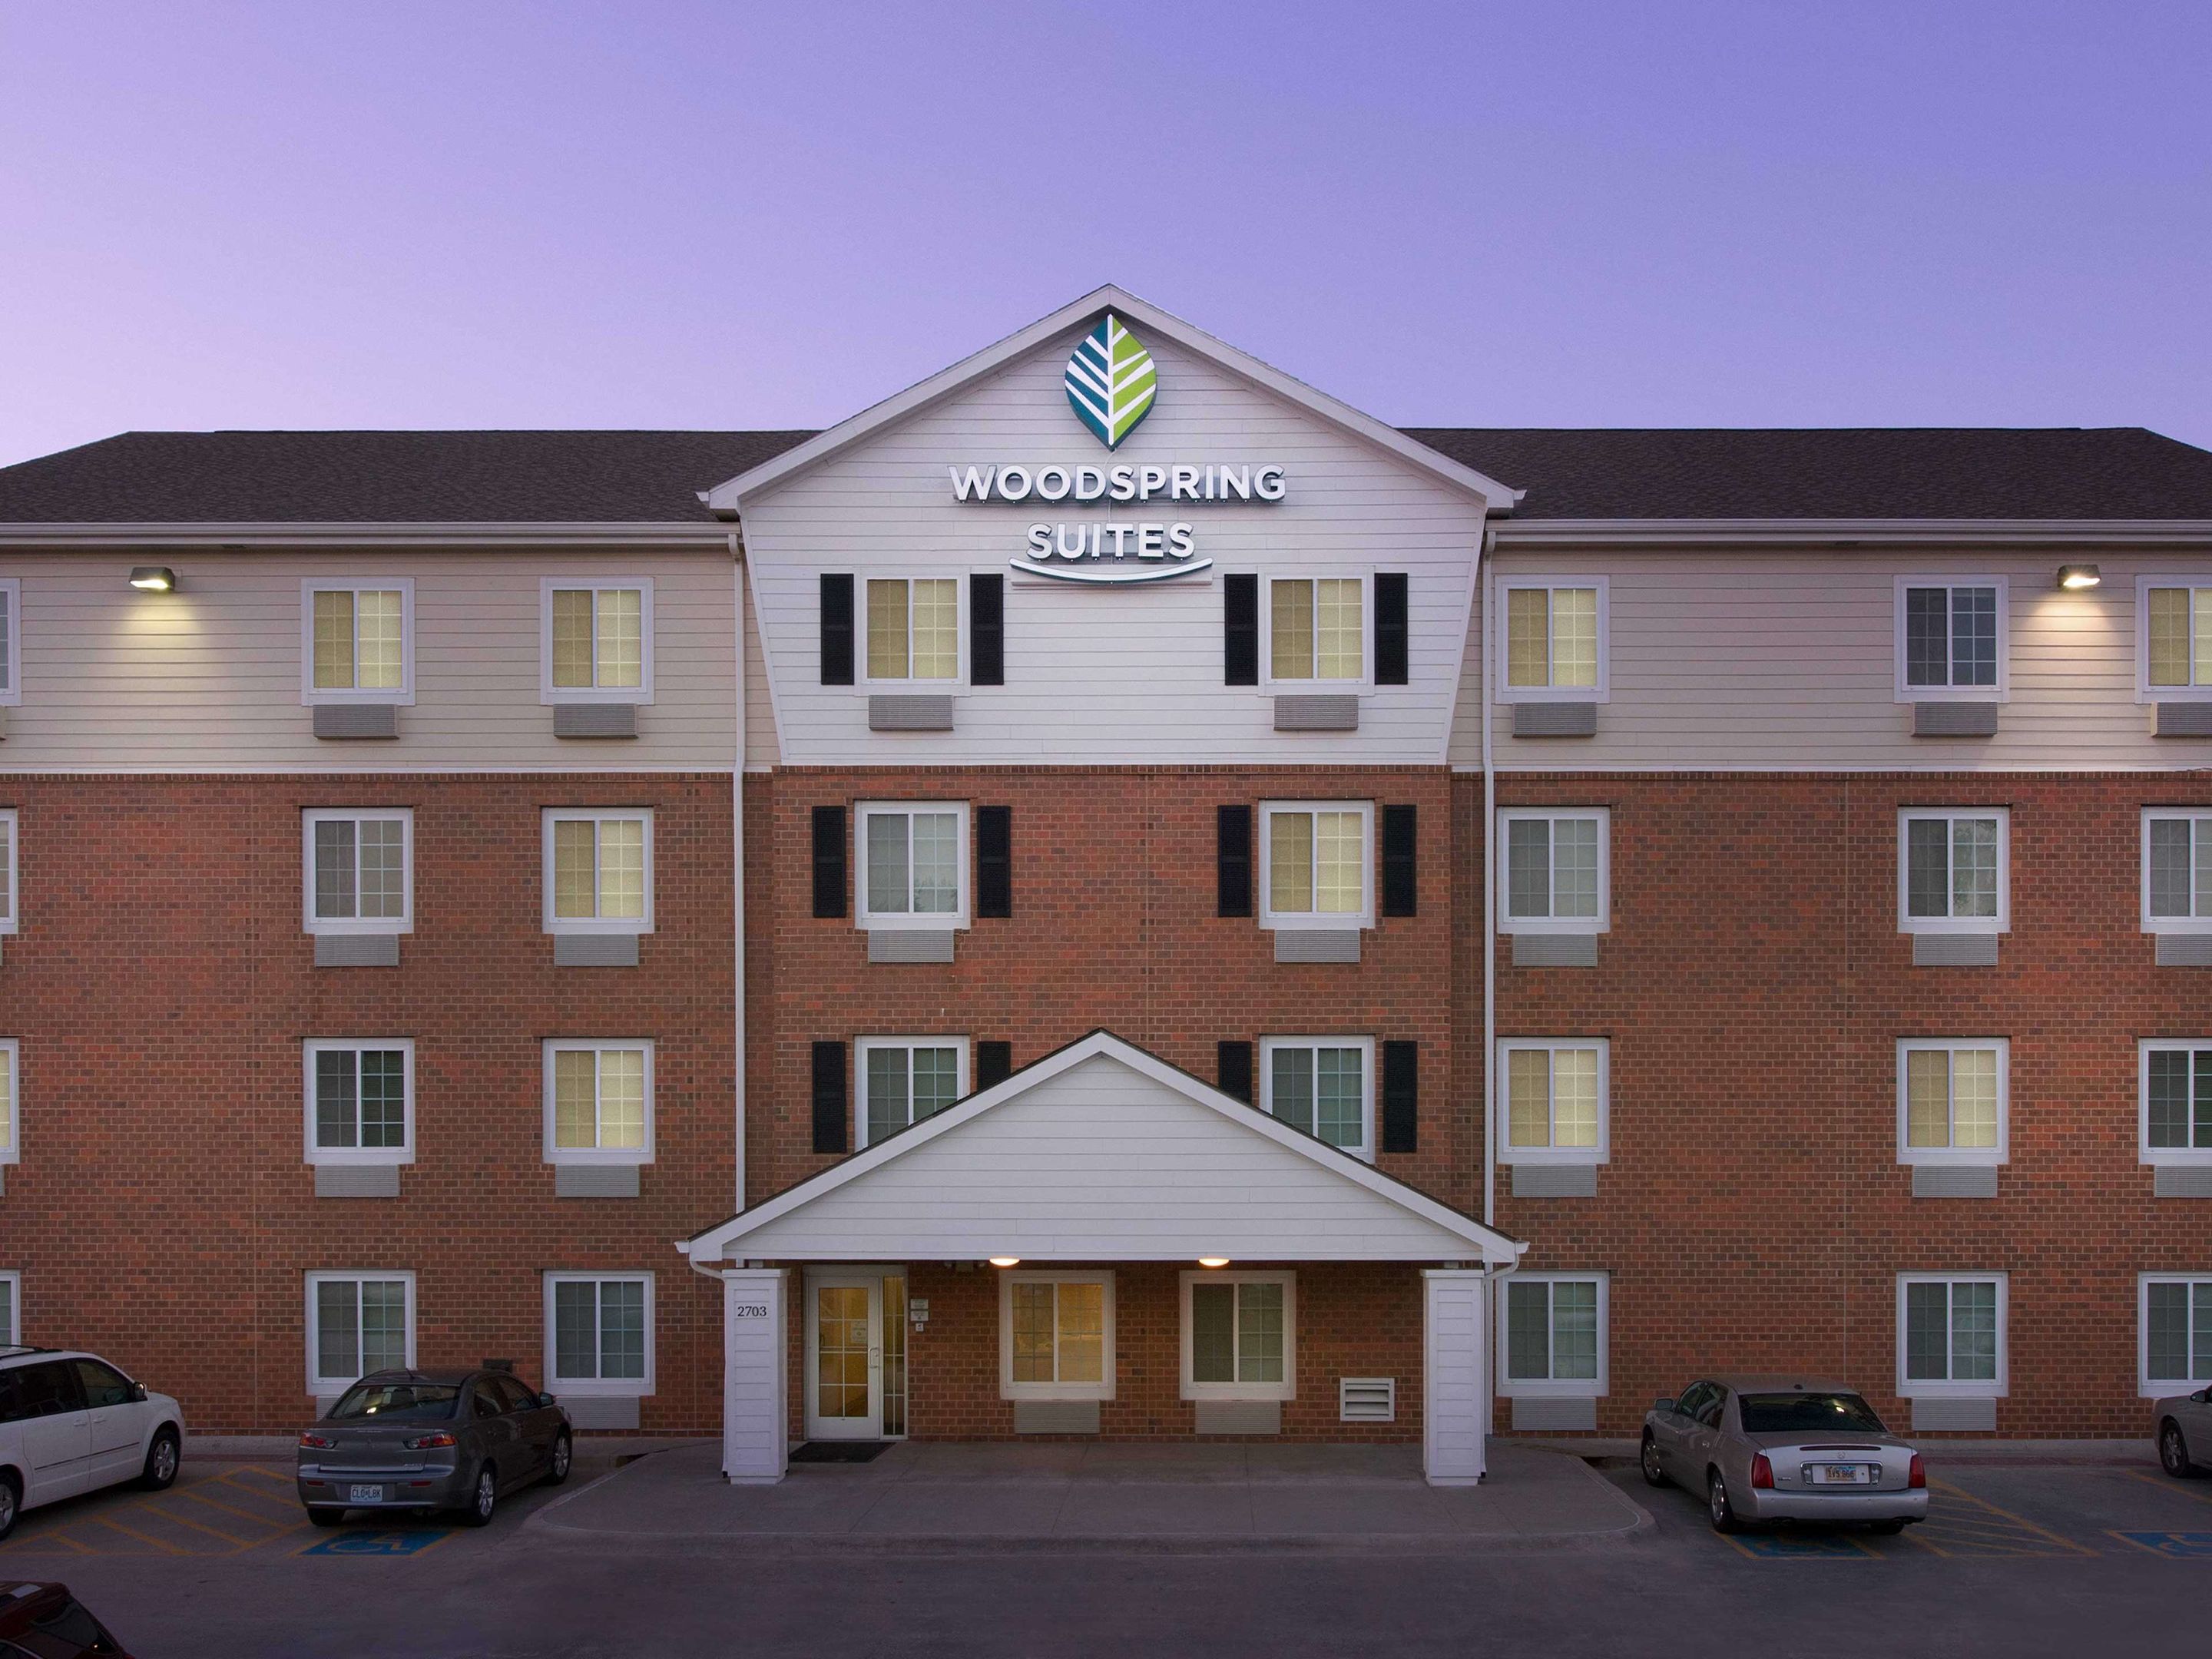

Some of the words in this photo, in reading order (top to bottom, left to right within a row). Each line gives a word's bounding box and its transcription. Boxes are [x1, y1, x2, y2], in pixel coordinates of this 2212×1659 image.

[947, 465, 1286, 502] WOODSPRING
[1025, 522, 1195, 561] SUITES
[737, 1306, 767, 1316] 2703
